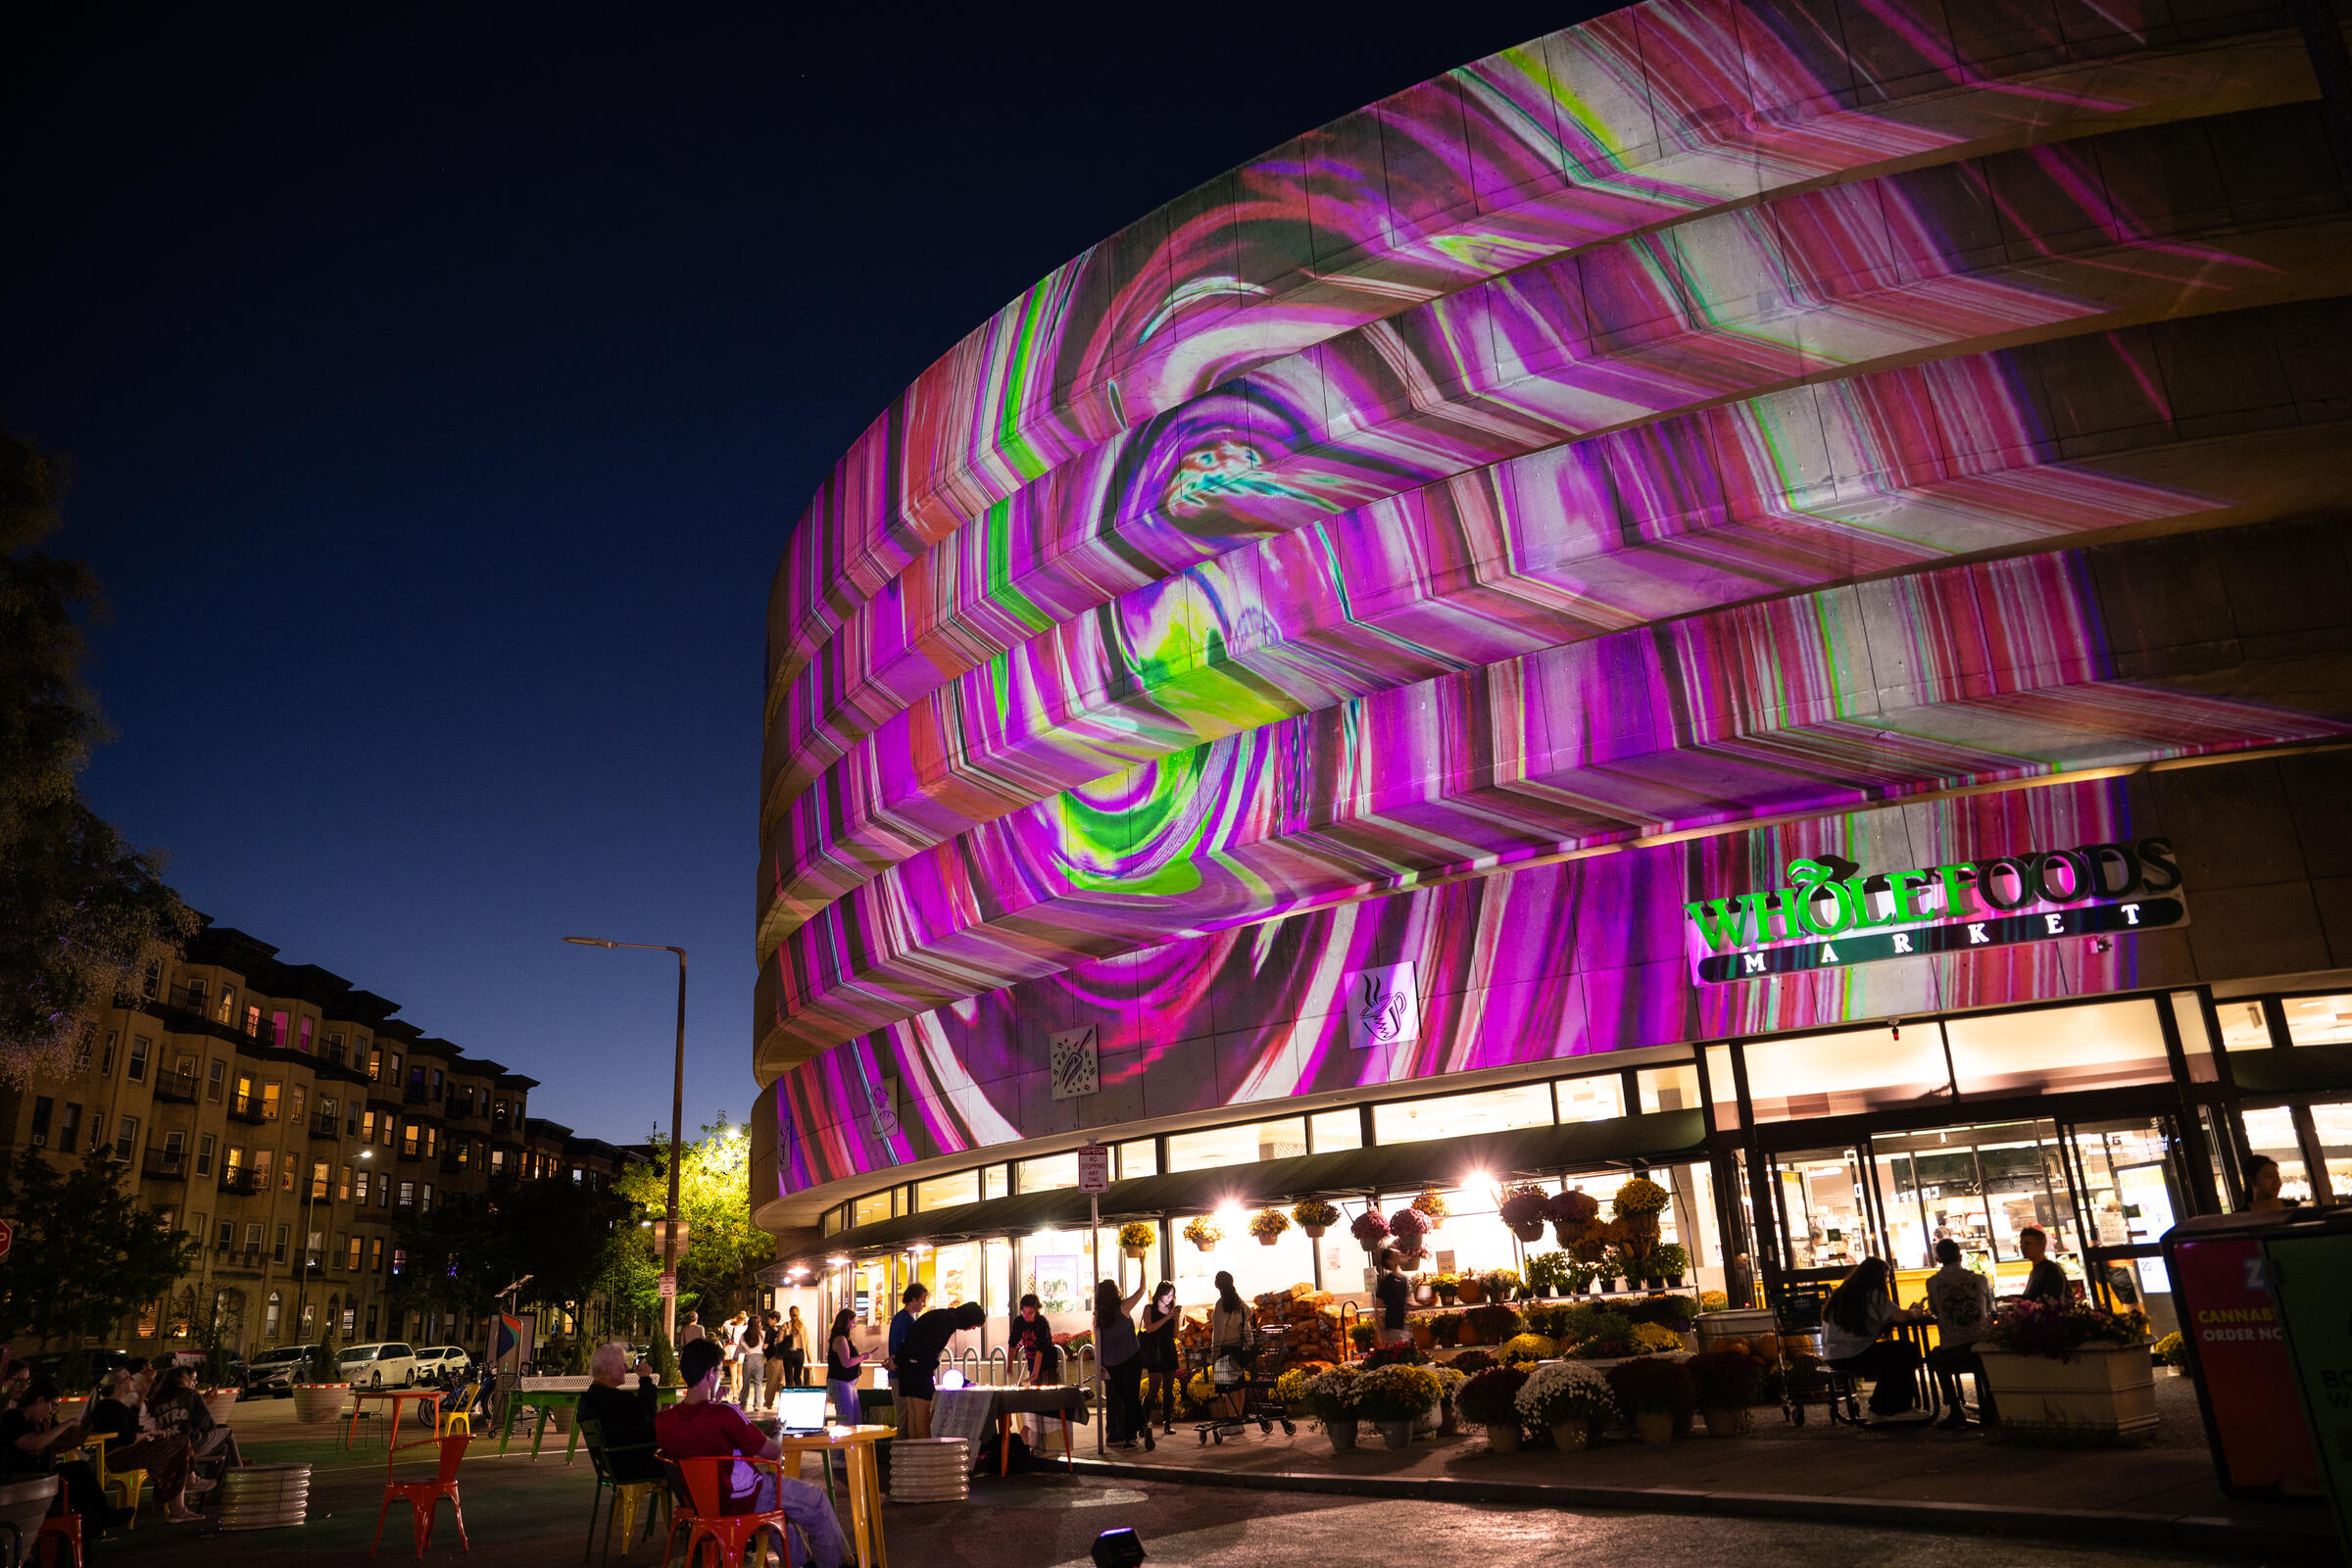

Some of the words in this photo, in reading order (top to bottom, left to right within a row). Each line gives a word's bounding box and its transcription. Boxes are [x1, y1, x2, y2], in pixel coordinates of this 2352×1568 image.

[1683, 861, 1936, 953] WHOLE
[1939, 838, 2182, 918] FOODS
[1745, 905, 2140, 973] MARKET
[2202, 1328, 2255, 1342] ORDER
